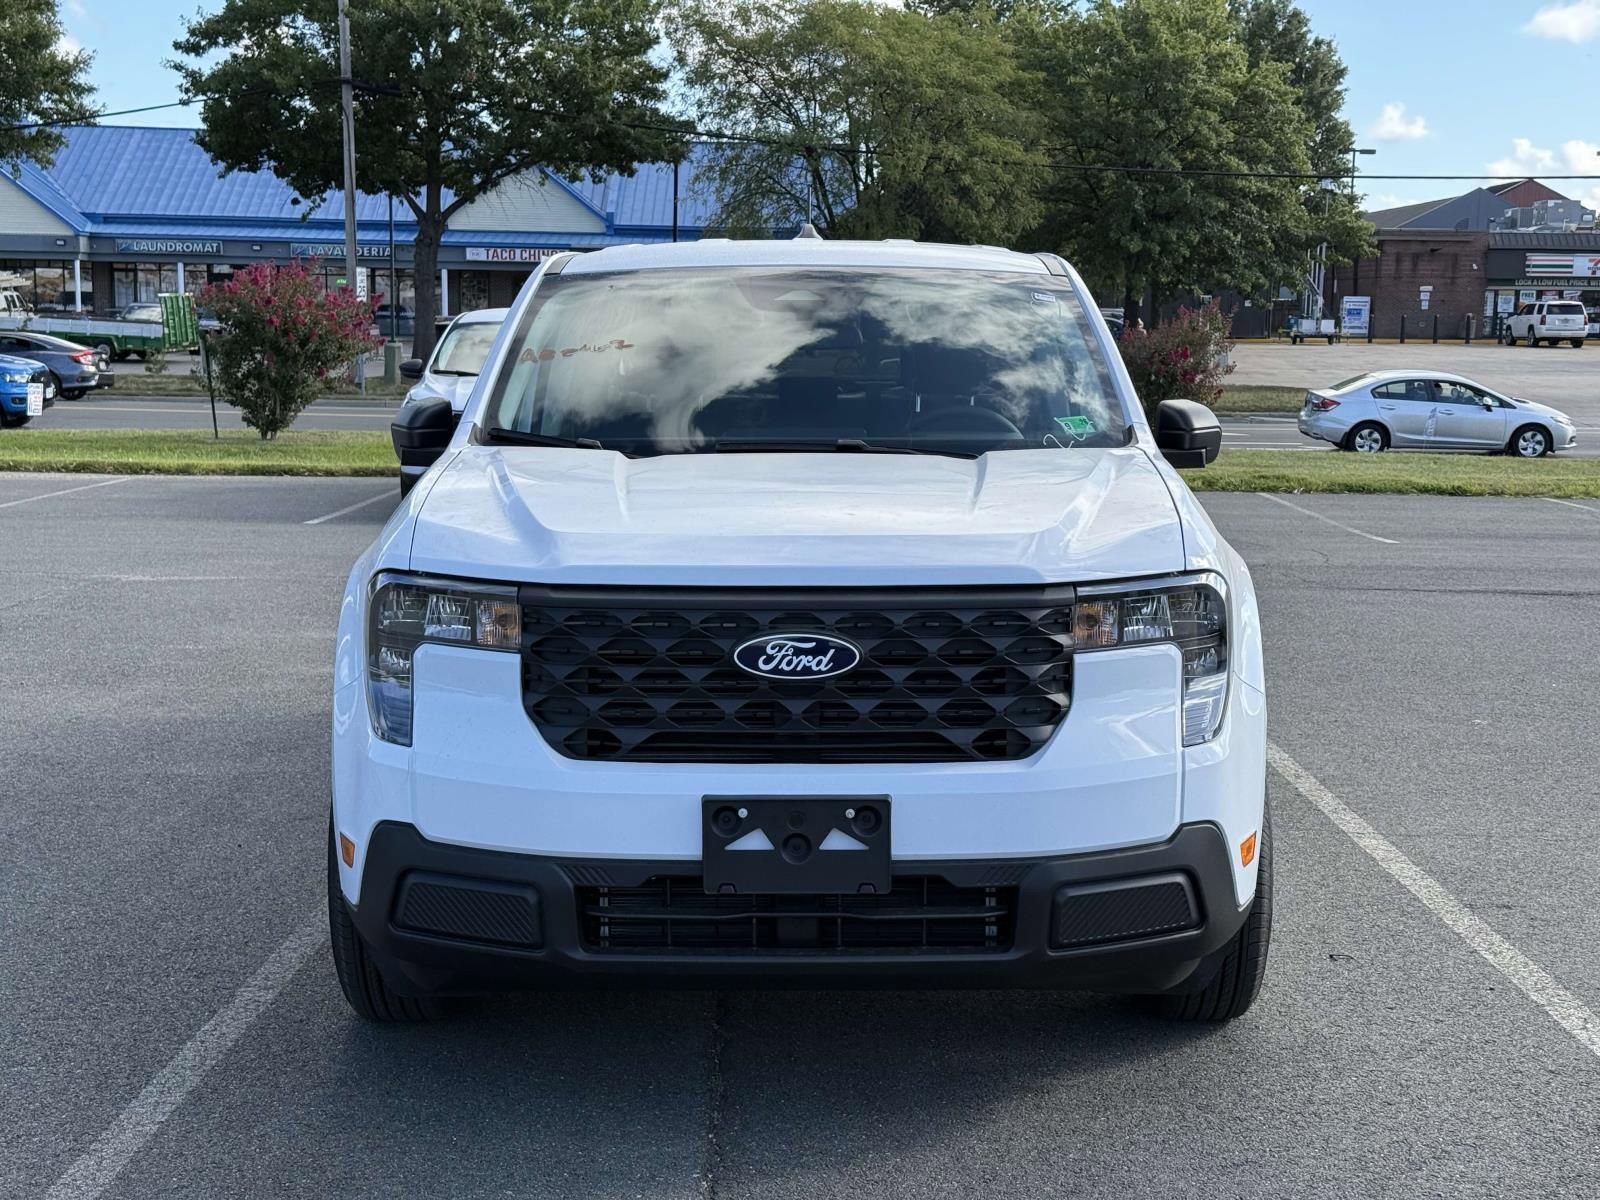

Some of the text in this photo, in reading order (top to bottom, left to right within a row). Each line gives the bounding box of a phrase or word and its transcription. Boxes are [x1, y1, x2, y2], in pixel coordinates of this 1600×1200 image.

[133, 242, 219, 253] LAUNDROMAT
[308, 246, 392, 257] LAVADERIA
[484, 248, 517, 261] TACO
[757, 640, 836, 672] Ford
